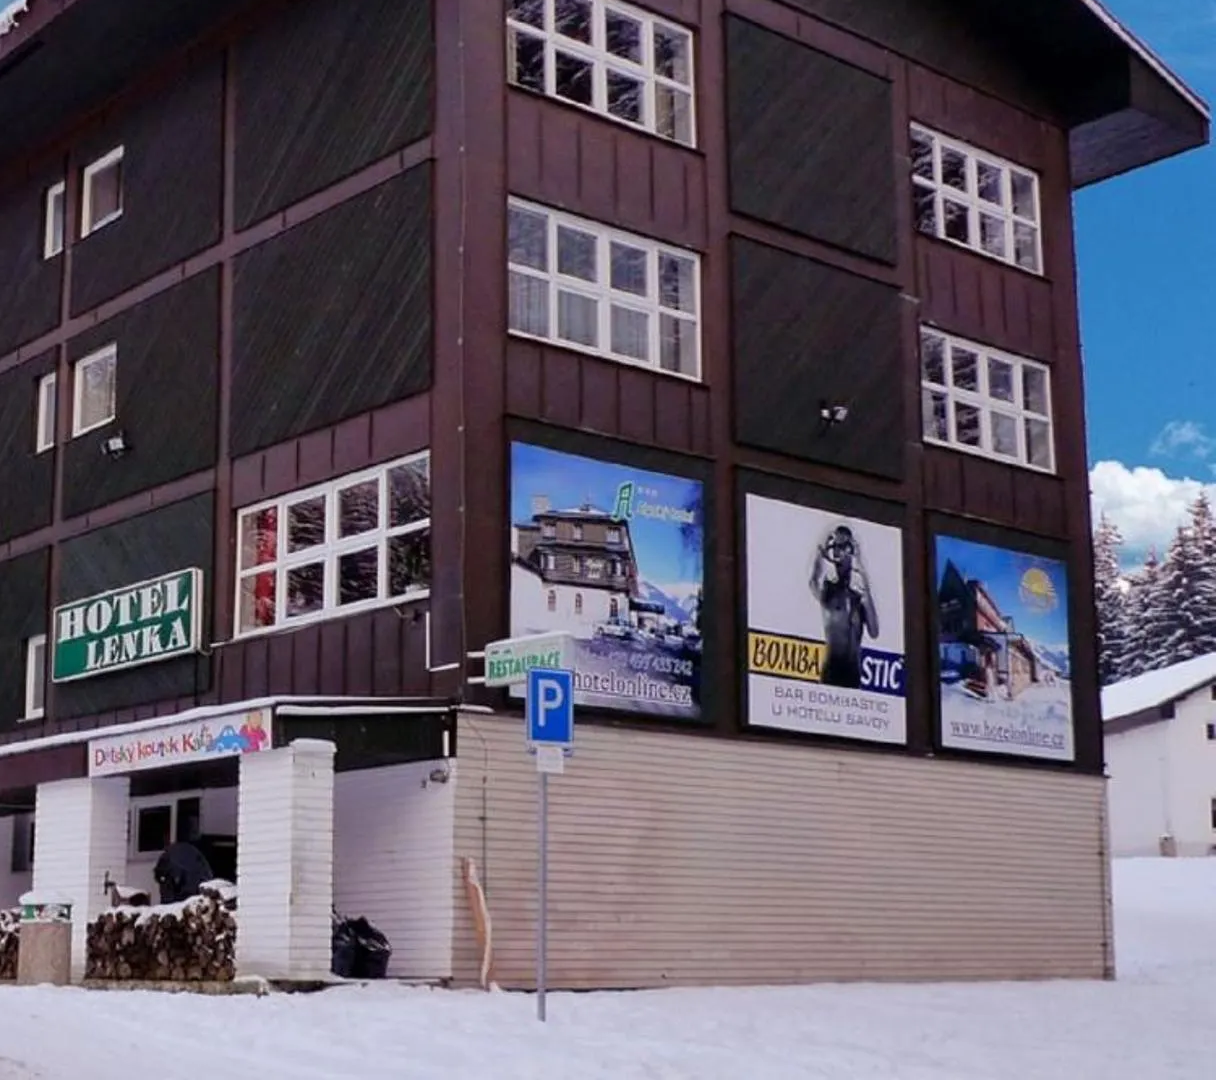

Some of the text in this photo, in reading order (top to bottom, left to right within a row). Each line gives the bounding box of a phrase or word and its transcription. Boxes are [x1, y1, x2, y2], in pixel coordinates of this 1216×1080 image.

[58, 577, 188, 642] HOTEL
[86, 617, 188, 670] LENKA
[752, 637, 902, 689] BOMBA STIC
[538, 679, 563, 727] P
[771, 703, 891, 730] U HOTELU SAVOY
[774, 686, 889, 714] BAR BOMBASTIC
